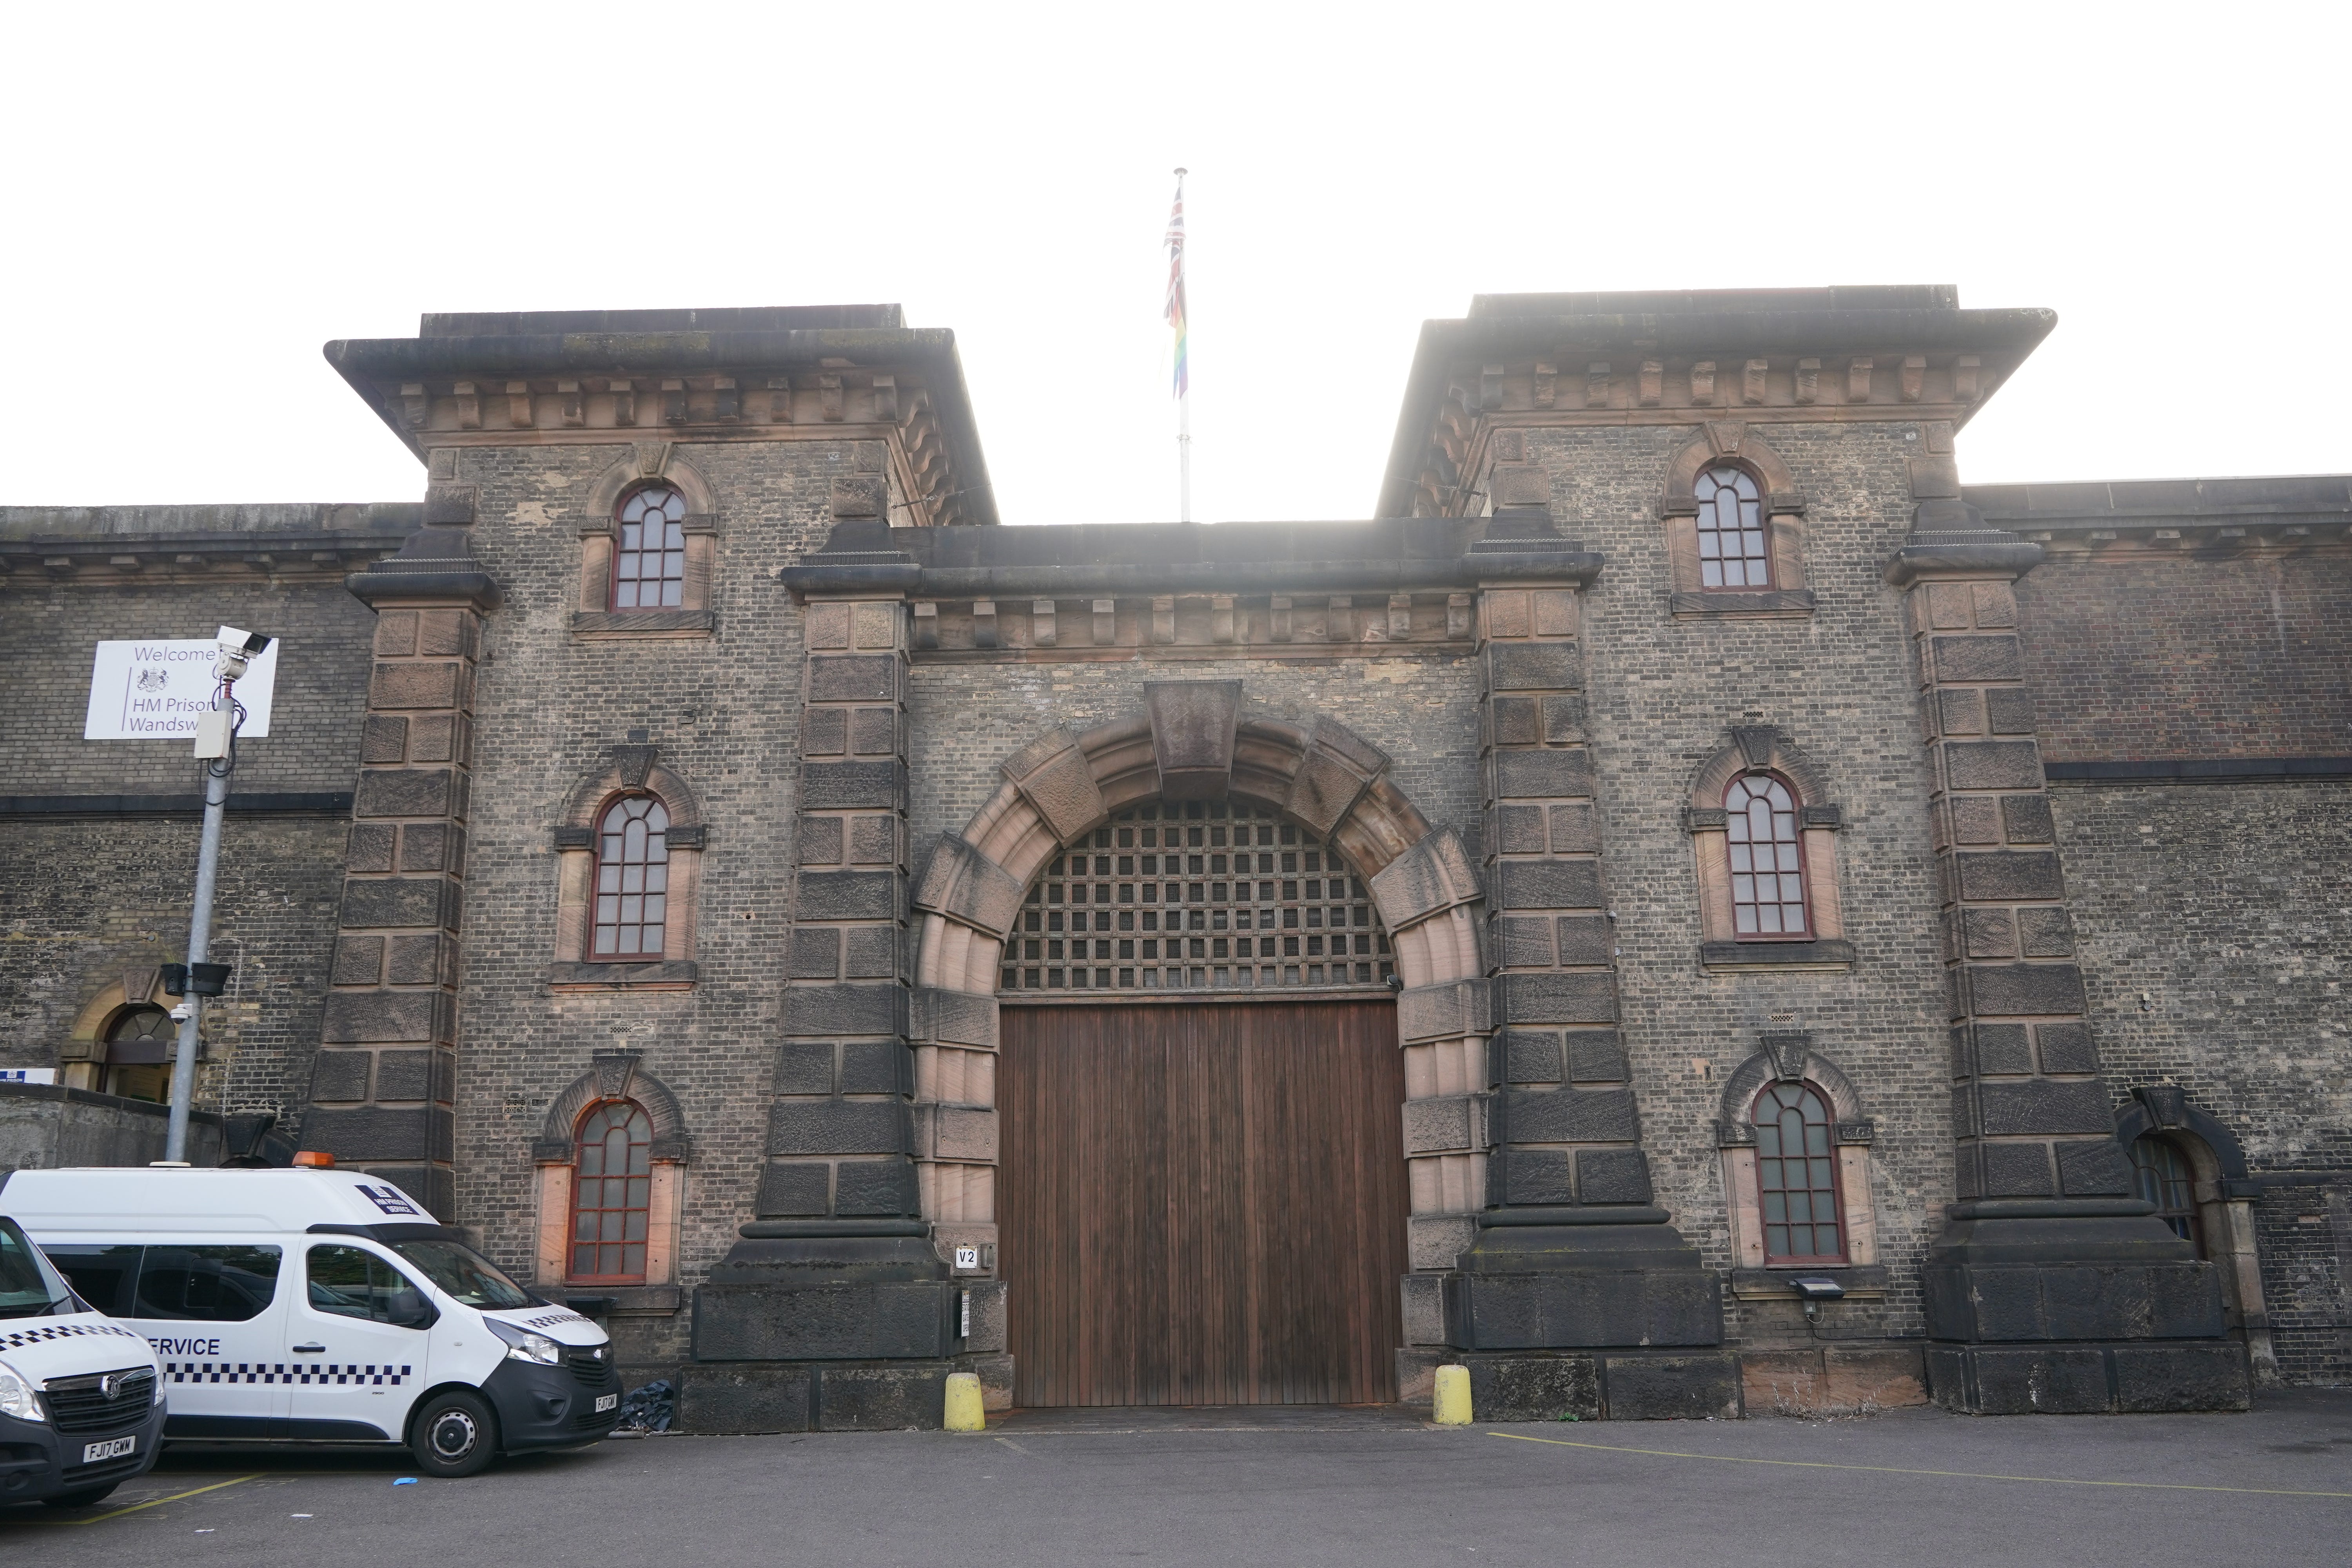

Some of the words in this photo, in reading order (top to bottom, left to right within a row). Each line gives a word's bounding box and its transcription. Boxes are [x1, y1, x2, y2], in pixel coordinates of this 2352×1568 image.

[135, 646, 216, 661] Welcome
[133, 699, 161, 712] HM
[130, 717, 199, 731] Wandsw
[147, 1338, 220, 1355] ERVICE
[598, 1397, 608, 1410] FJ17
[90, 1443, 112, 1459] FJ17
[113, 1439, 131, 1454] GWM
